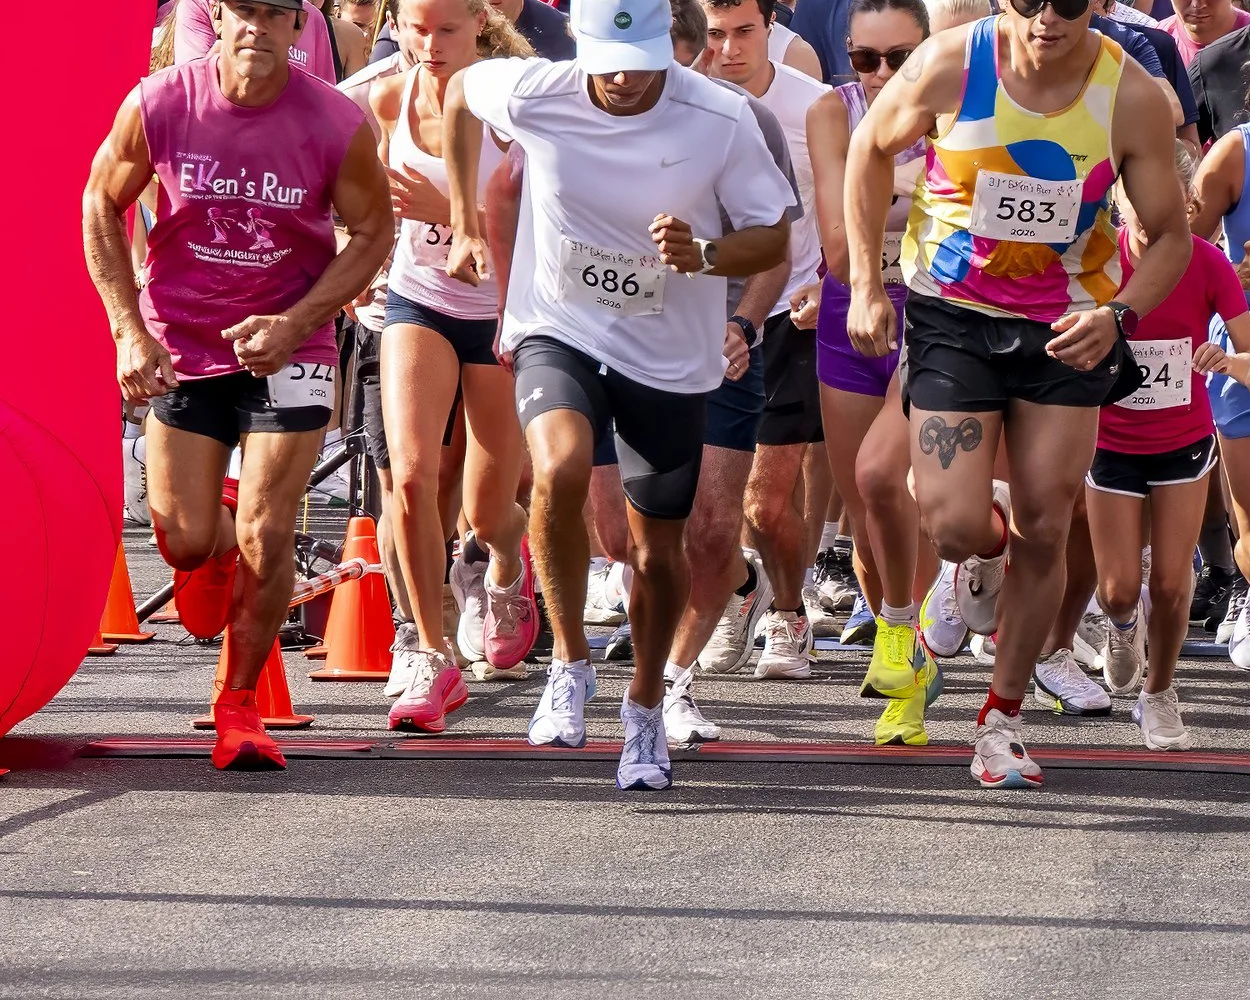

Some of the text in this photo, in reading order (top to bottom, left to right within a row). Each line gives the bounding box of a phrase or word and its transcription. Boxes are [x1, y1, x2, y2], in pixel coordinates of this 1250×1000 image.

[262, 172, 304, 204] Run
[996, 196, 1057, 223] 583
[582, 264, 640, 297] 686
[1139, 363, 1171, 388] 24
